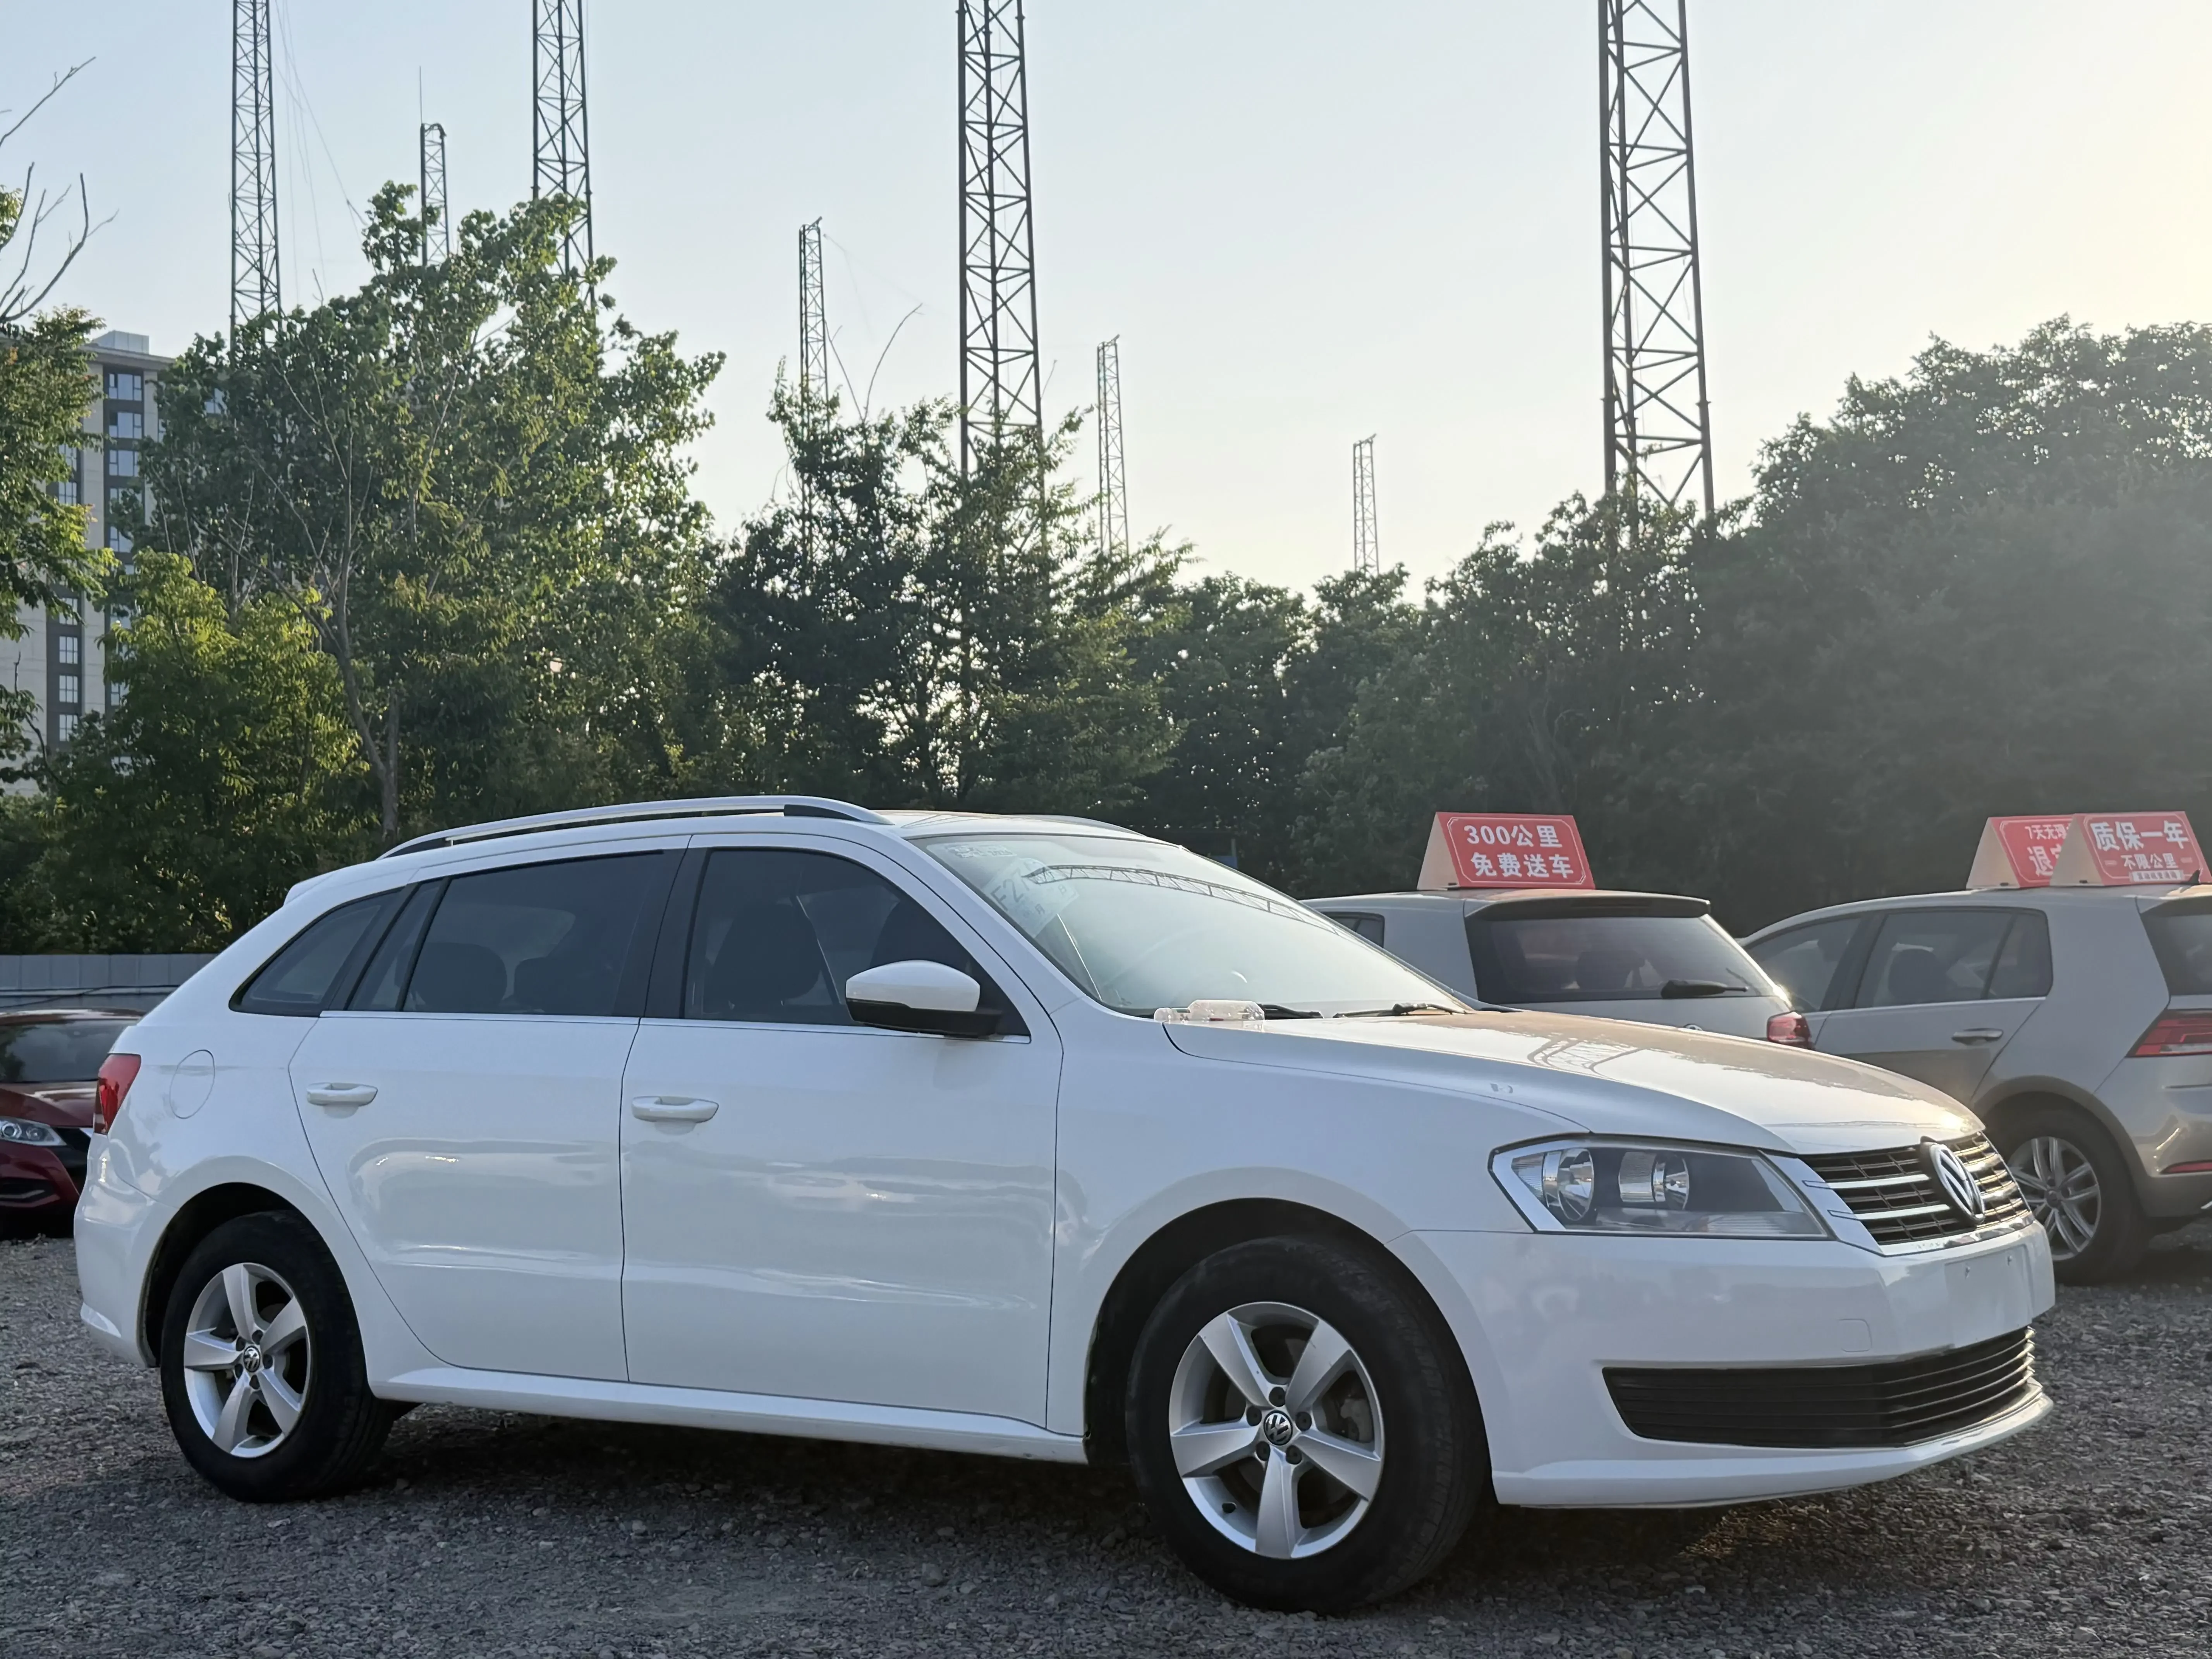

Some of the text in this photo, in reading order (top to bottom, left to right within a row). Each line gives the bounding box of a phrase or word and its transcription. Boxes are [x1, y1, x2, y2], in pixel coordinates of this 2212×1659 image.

[1464, 824, 1563, 848] 300公里
[2024, 823, 2071, 840] 7天无理
[2091, 820, 2189, 852] 质保一年
[1470, 852, 1574, 879] 免费送车
[2120, 853, 2179, 870] 不限公里
